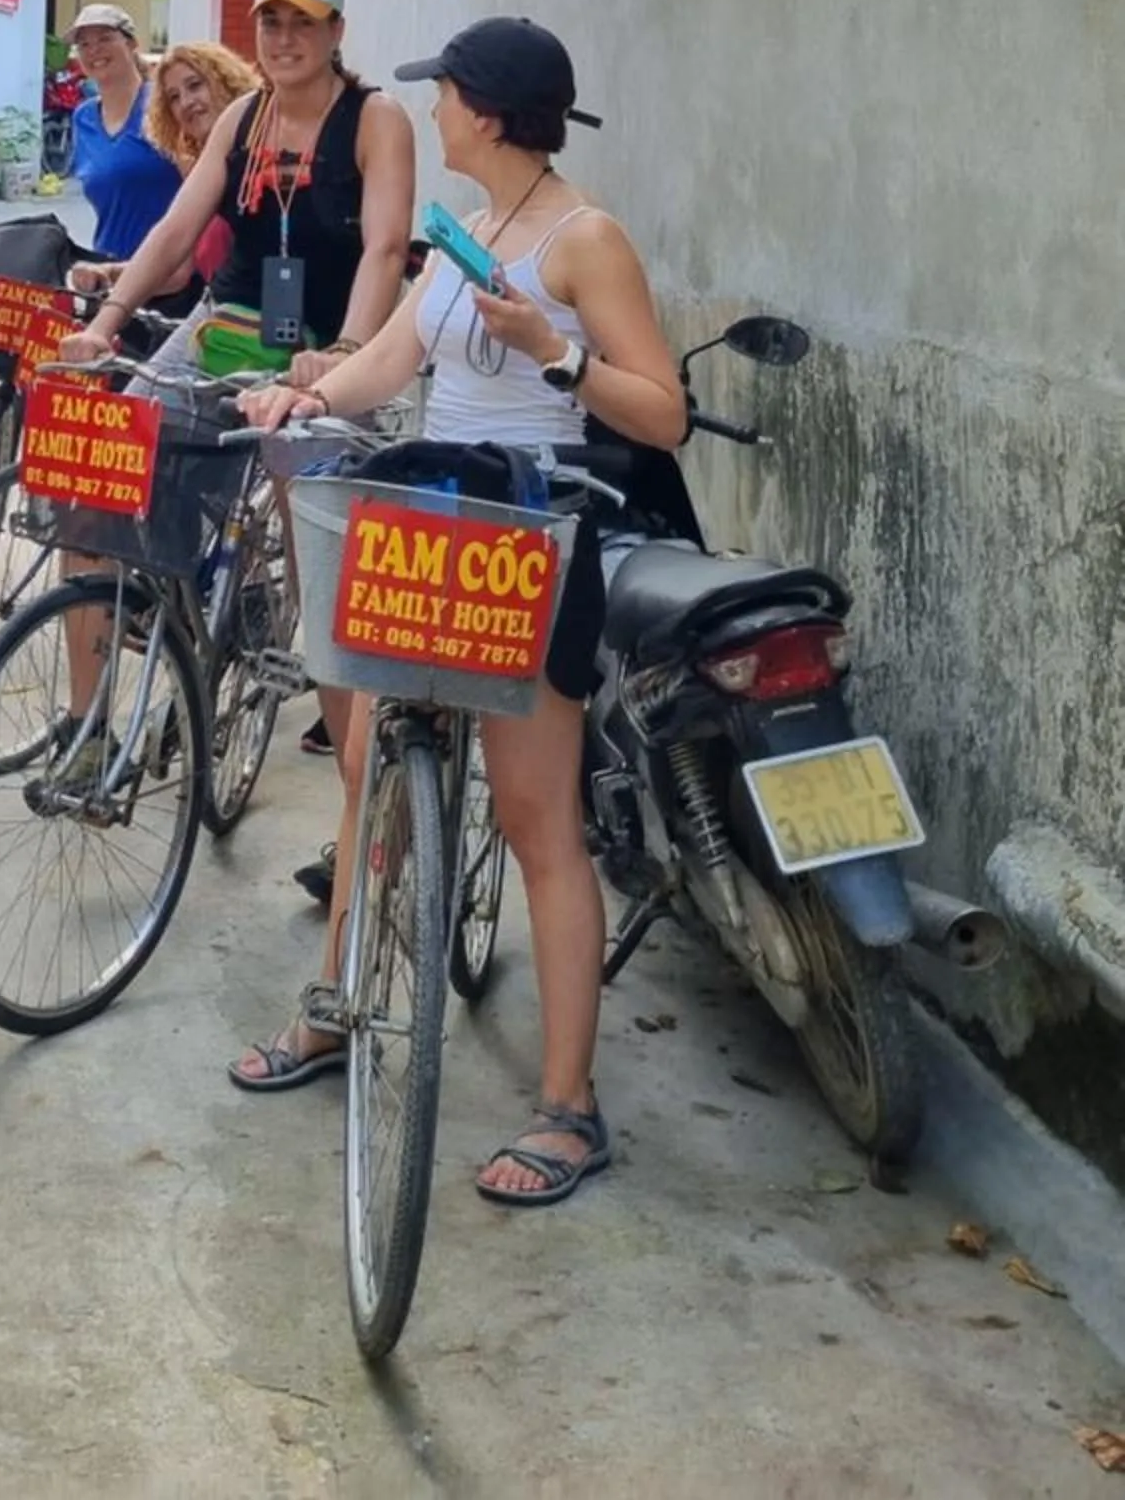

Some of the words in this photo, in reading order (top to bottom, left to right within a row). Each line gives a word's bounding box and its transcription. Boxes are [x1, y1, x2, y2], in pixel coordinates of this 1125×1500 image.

[51, 393, 91, 424] TAM
[93, 400, 132, 431] COC
[26, 427, 88, 464] FAMILY
[89, 438, 146, 476] HOTEL
[356, 519, 449, 586] TAM
[458, 529, 548, 600] CỐC
[348, 580, 448, 626] FAMILY
[452, 601, 535, 640] HOTEL
[385, 627, 425, 651] 094
[431, 635, 473, 659] 367
[479, 643, 529, 667] 7874
